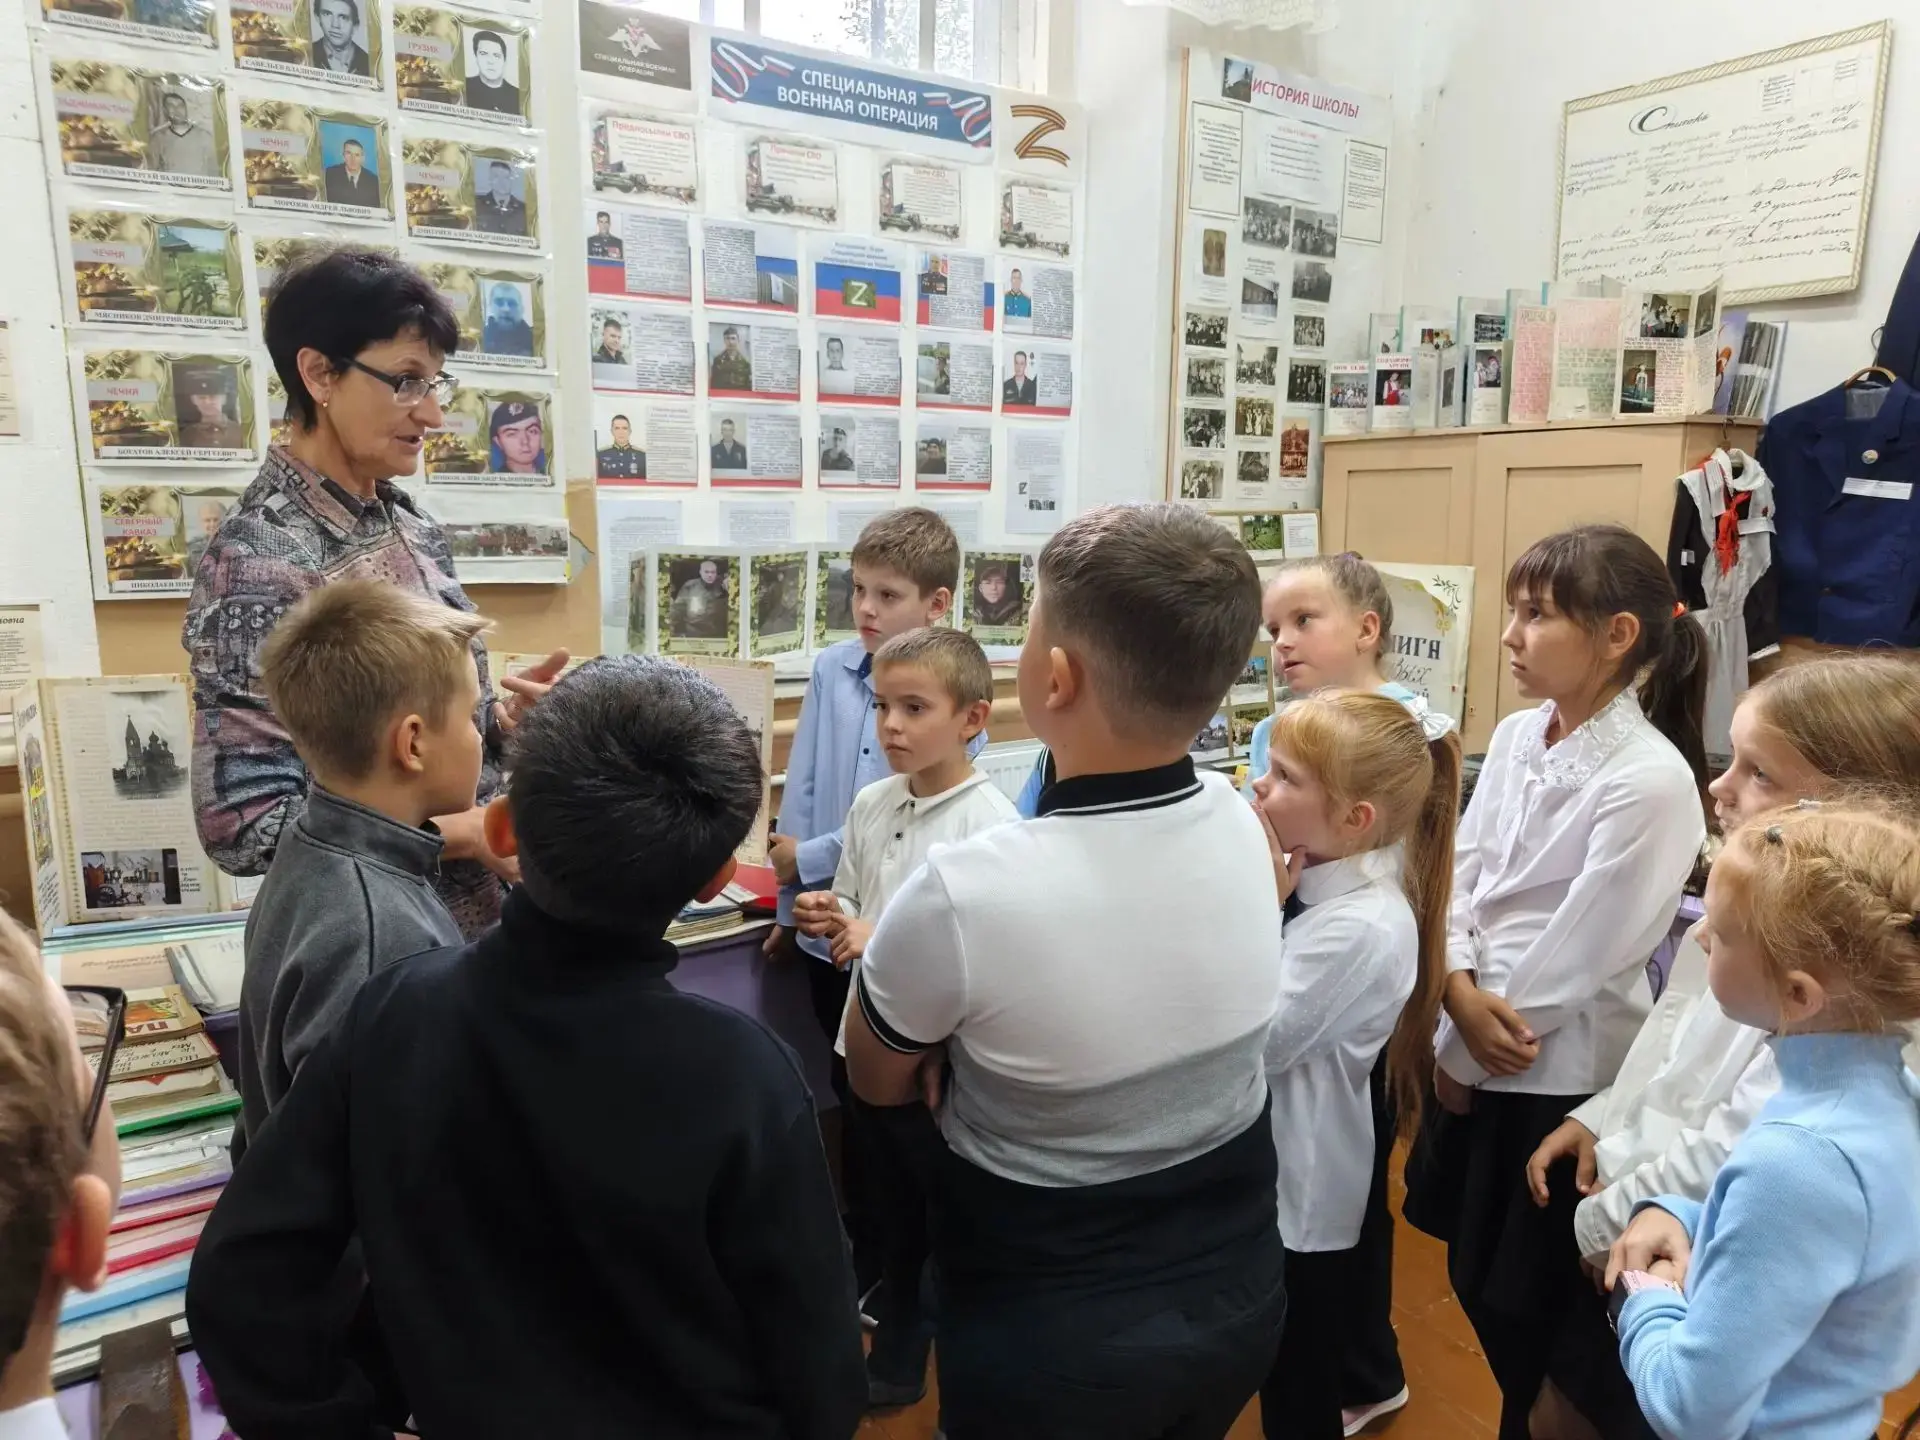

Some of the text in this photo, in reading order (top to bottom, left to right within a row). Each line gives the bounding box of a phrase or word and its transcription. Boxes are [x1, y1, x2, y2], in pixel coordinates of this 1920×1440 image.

[286, 65, 325, 78] ВЛАДИМИР
[326, 71, 373, 86] НИКОЛАЕВИЧ
[618, 65, 654, 76] ОПЕРАЦИЯ
[801, 69, 917, 106] СПЕЦИАЛЬНАЯ
[1252, 78, 1360, 119] ИСТОРИЯ ШКОЛЫ
[777, 86, 938, 131] ВОЕННАЯ ОПЕРАЦИЯ
[612, 120, 690, 141] Предпосылки СВО
[260, 137, 289, 147] ЧЕЧНЯ
[274, 199, 371, 215] МОРОЗОВ АНДРЕЙ ЛЬВОВИЧ
[93, 248, 125, 259] ЧЕЧНЯ
[851, 280, 868, 306] Z
[94, 312, 235, 326] МЯСНИКОВ ДМИТРИЙ ВАЛЕРЬЕВИЧ
[106, 387, 139, 396] ЧЕЧНЯ
[193, 449, 237, 457] СЕРГЕЕВИЧ
[114, 518, 163, 526] СЕВЕРНЫЙ
[1391, 634, 1441, 660] ИГА
